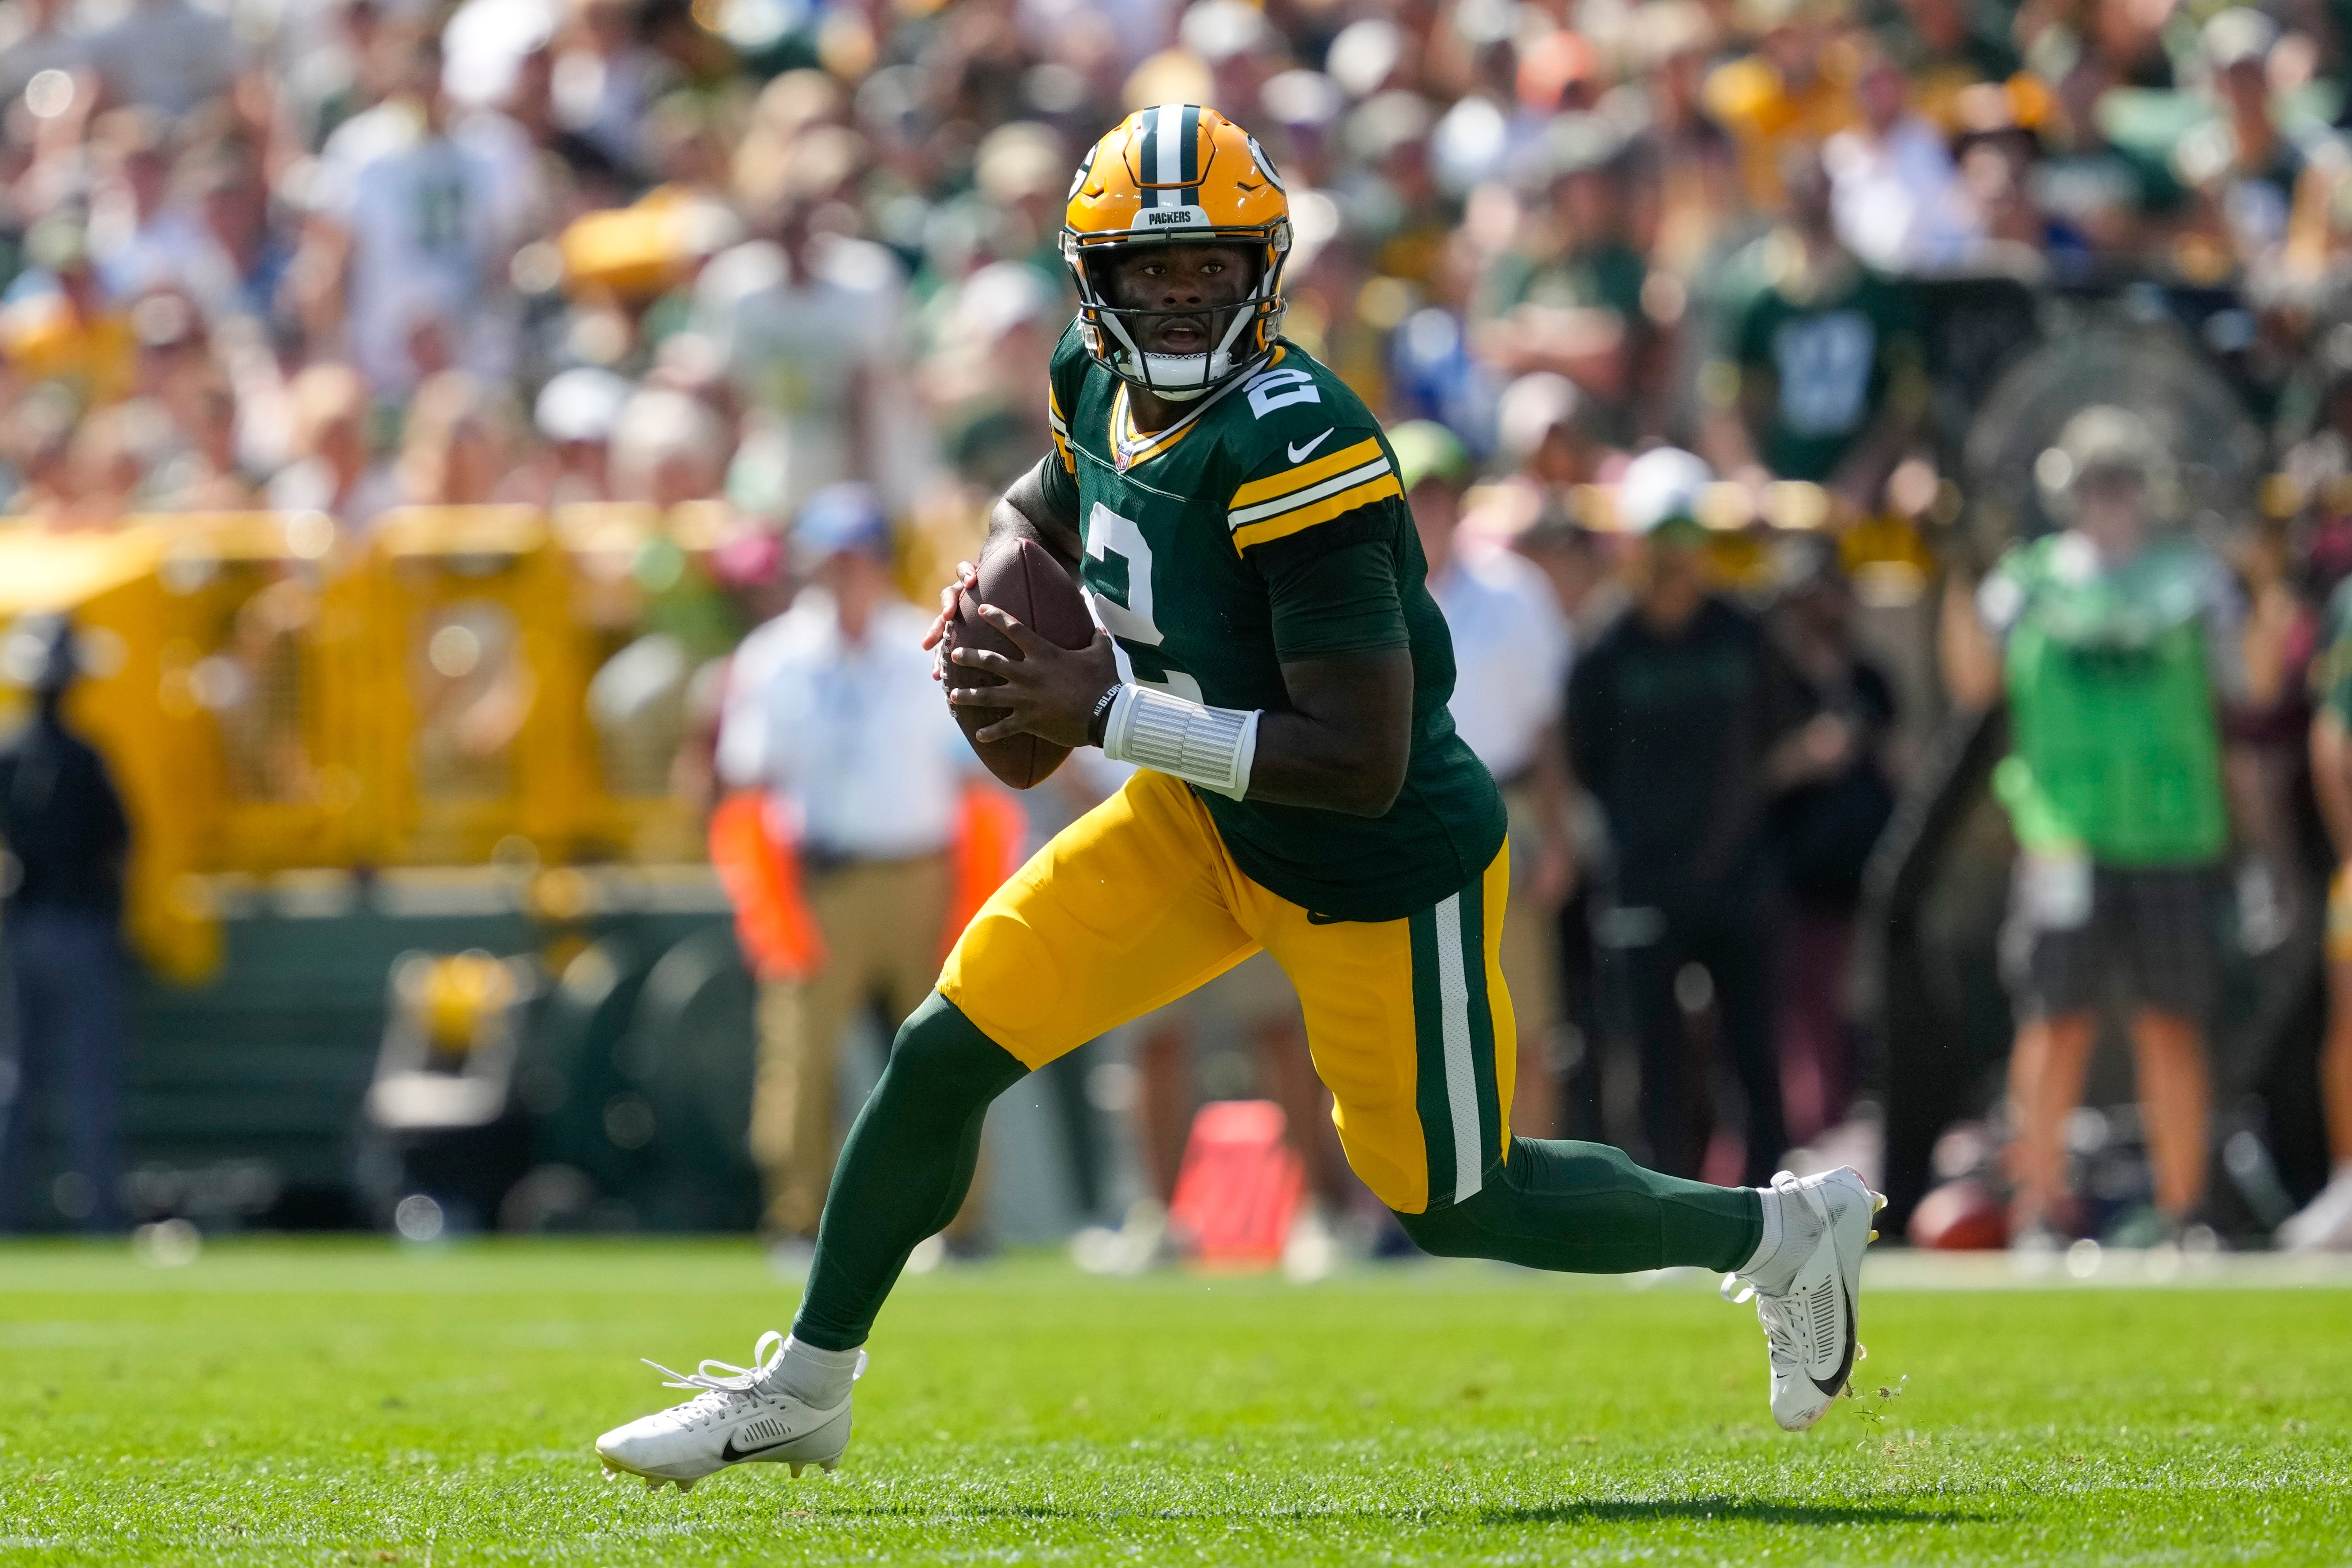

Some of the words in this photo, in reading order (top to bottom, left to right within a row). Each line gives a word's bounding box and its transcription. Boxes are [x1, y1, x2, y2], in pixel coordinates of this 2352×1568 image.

[1149, 211, 1191, 225] PACKERS
[1242, 368, 1321, 420] 2
[1117, 453, 1127, 468] NFL
[1080, 501, 1204, 705] 2
[1093, 705, 1103, 716] ALL
